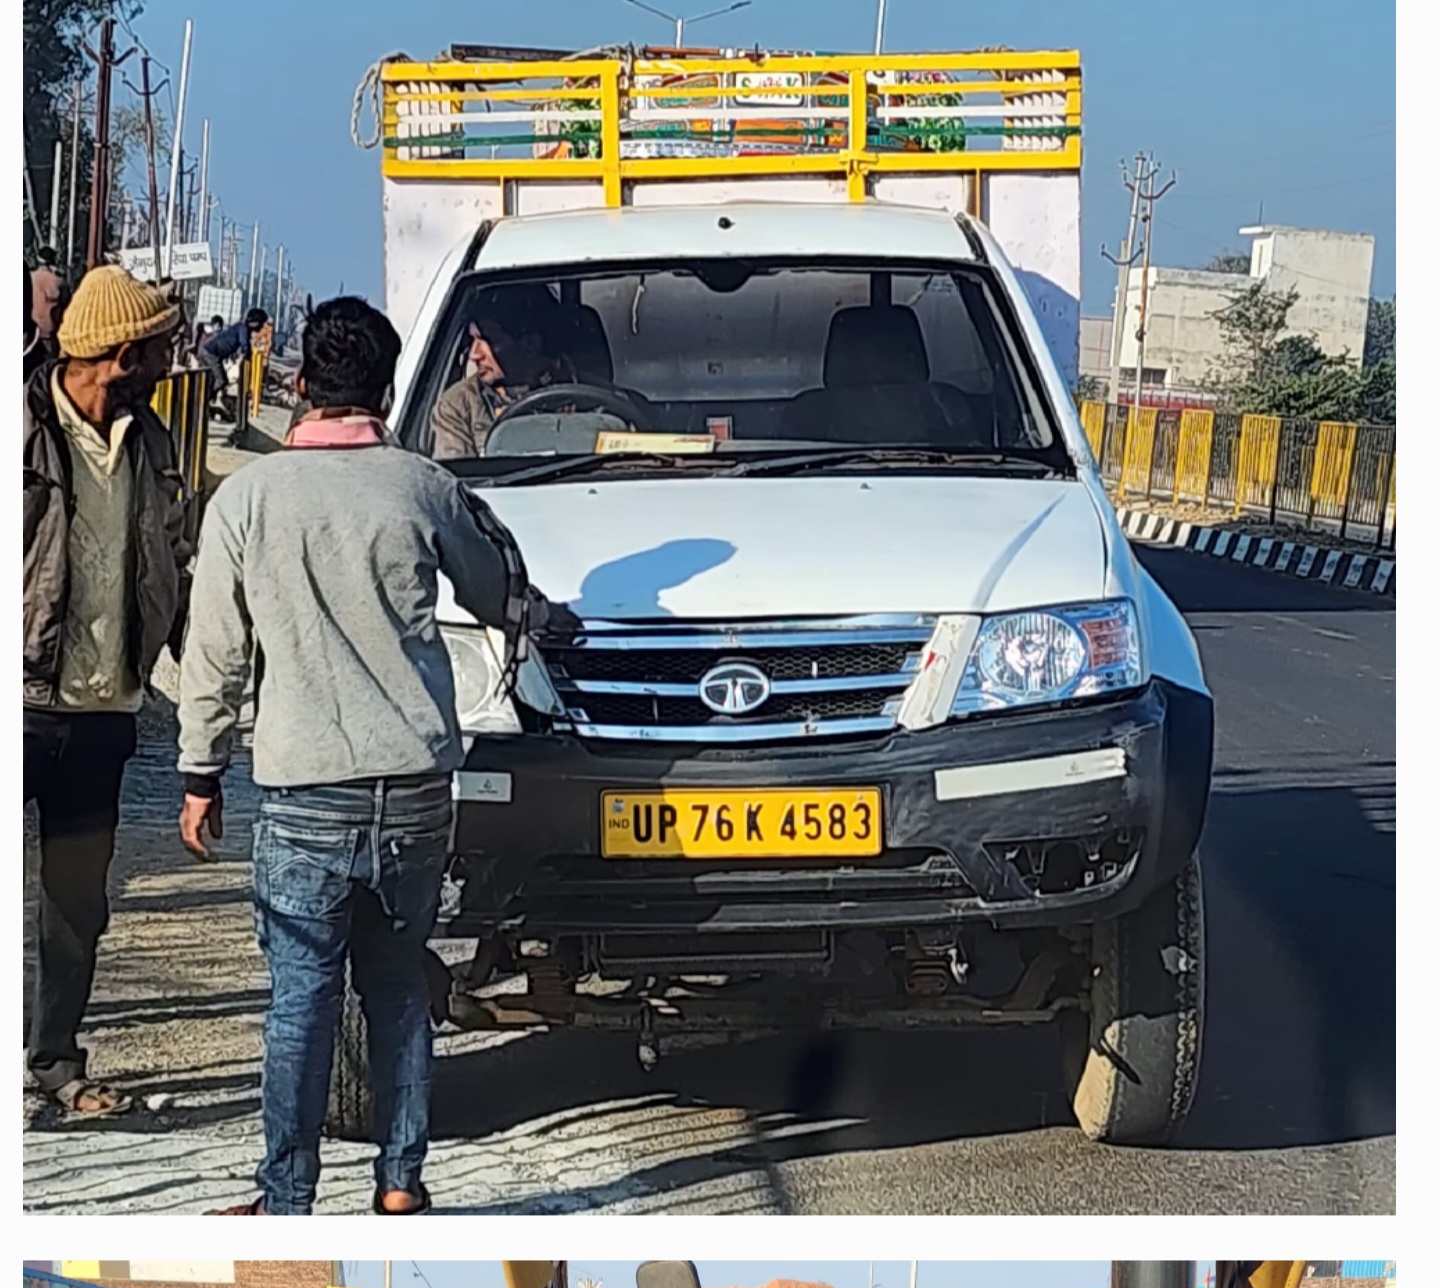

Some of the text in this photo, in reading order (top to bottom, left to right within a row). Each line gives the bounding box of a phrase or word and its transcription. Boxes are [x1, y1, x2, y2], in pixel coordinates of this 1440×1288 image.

[609, 818, 629, 830] IND
[633, 803, 872, 843] UP 76 K 4583
